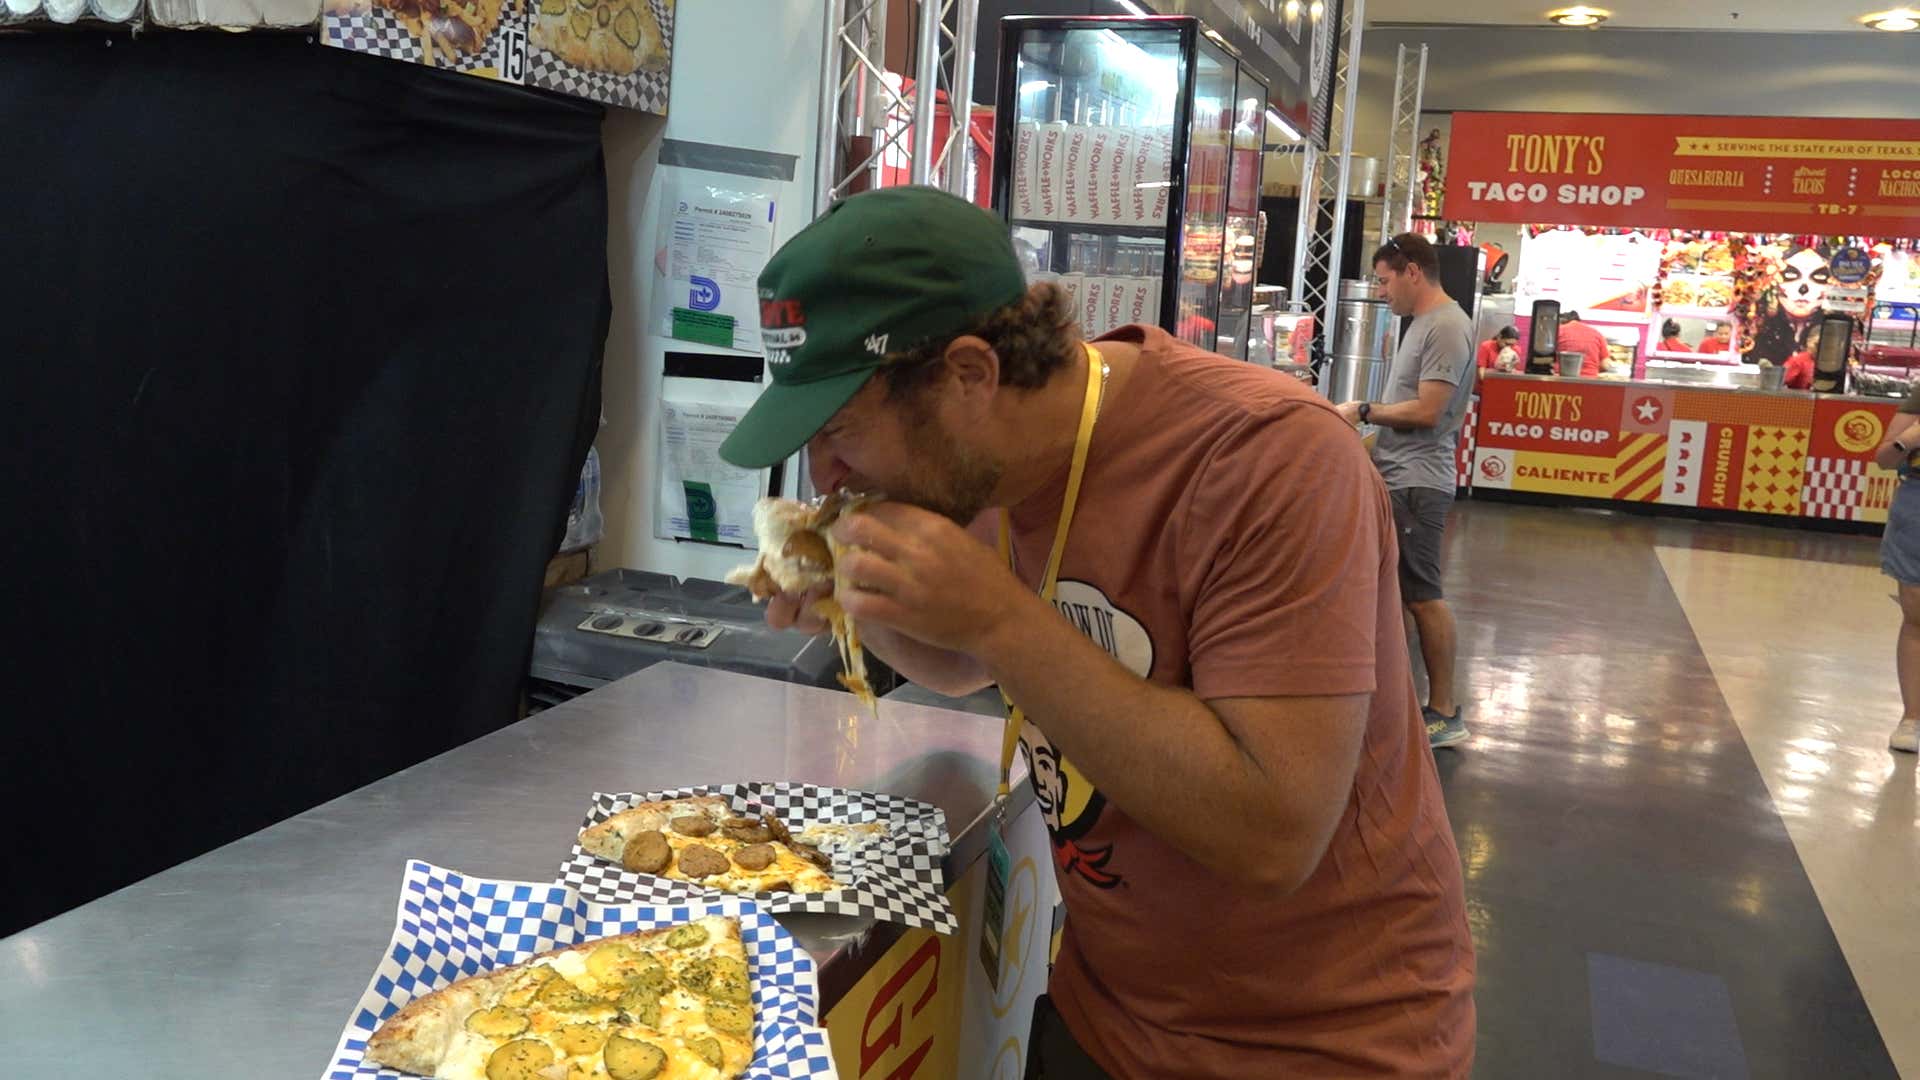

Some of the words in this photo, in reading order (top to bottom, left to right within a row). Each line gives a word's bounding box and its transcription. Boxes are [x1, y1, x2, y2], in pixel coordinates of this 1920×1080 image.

[501, 30, 524, 81] 15
[1017, 129, 1032, 169] WORKS
[1042, 130, 1058, 170] WORKS
[1067, 132, 1084, 171] WORKS
[1089, 133, 1107, 173] WORKS
[1112, 134, 1130, 174] WORKS
[1507, 134, 1605, 175] TONY'S
[1717, 143, 1765, 153] SERVING
[1769, 144, 1789, 153] THE
[1793, 144, 1825, 154] STATE
[1829, 145, 1857, 155] FAIR
[1857, 145, 1873, 155] OF
[1467, 181, 1548, 203] TACO
[1557, 184, 1646, 206] SHOP
[1669, 168, 1745, 188] QUESABIRRIA
[1792, 177, 1825, 195] TACOS
[1881, 169, 1920, 180] LOCO
[1016, 175, 1032, 216] WAFFLE
[1041, 175, 1054, 216] WAFFLE
[1066, 177, 1078, 217] WAFFLE
[1088, 178, 1100, 219] WAFFLE
[1110, 179, 1122, 220] WAFFLE
[1818, 203, 1858, 215] TB-7
[1086, 283, 1100, 322] WORKS
[1108, 284, 1124, 325] WORKS
[1515, 391, 1583, 422] TONY'S
[1488, 421, 1544, 439] TACO
[1550, 426, 1610, 443] SHOP
[1516, 465, 1610, 484] CALIENTE
[1712, 427, 1734, 507] CRUNCHY
[1865, 476, 1898, 509] DEL
